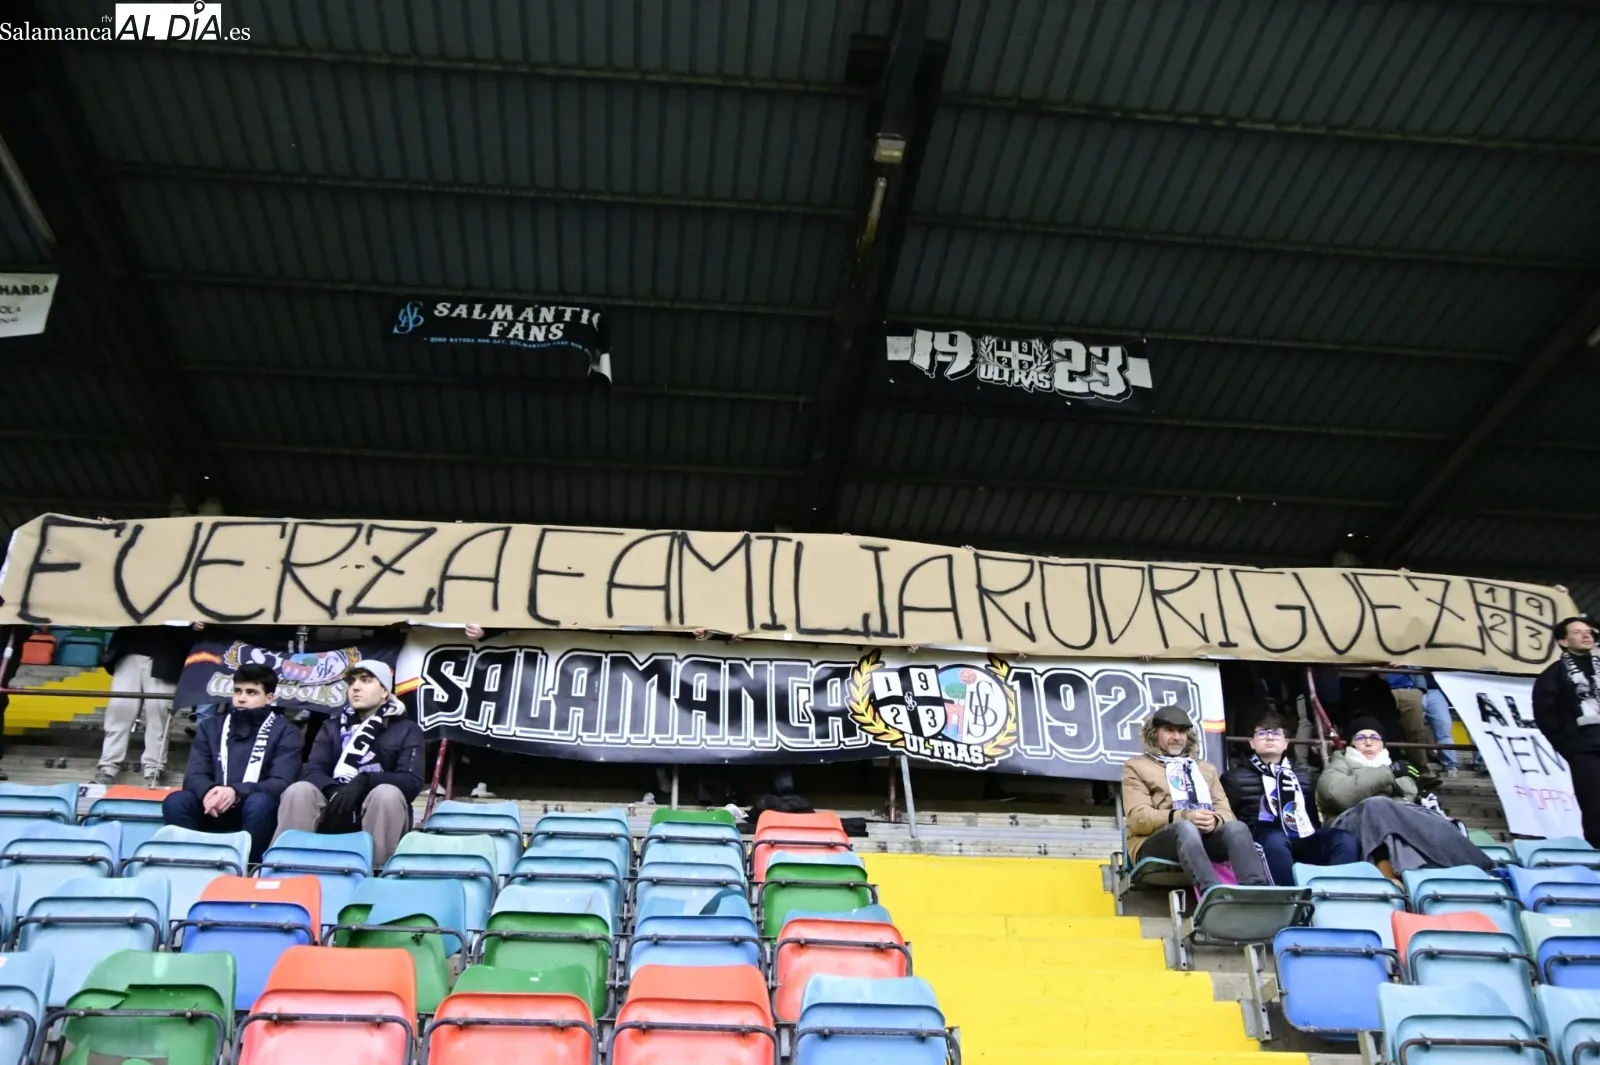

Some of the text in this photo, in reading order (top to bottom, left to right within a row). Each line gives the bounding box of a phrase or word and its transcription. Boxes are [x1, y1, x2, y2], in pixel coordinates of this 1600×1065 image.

[488, 320, 564, 341] FANS
[910, 328, 1131, 401] 19 23
[979, 363, 1052, 390] ULTRAS
[527, 527, 963, 641] FAMILIA
[1484, 587, 1544, 616] 1 9
[1488, 613, 1543, 651] 2 3
[884, 672, 930, 692] 1 9
[418, 645, 866, 750] SALAMANCA
[890, 706, 938, 728] 2 3
[904, 733, 986, 765] ULTRAS
